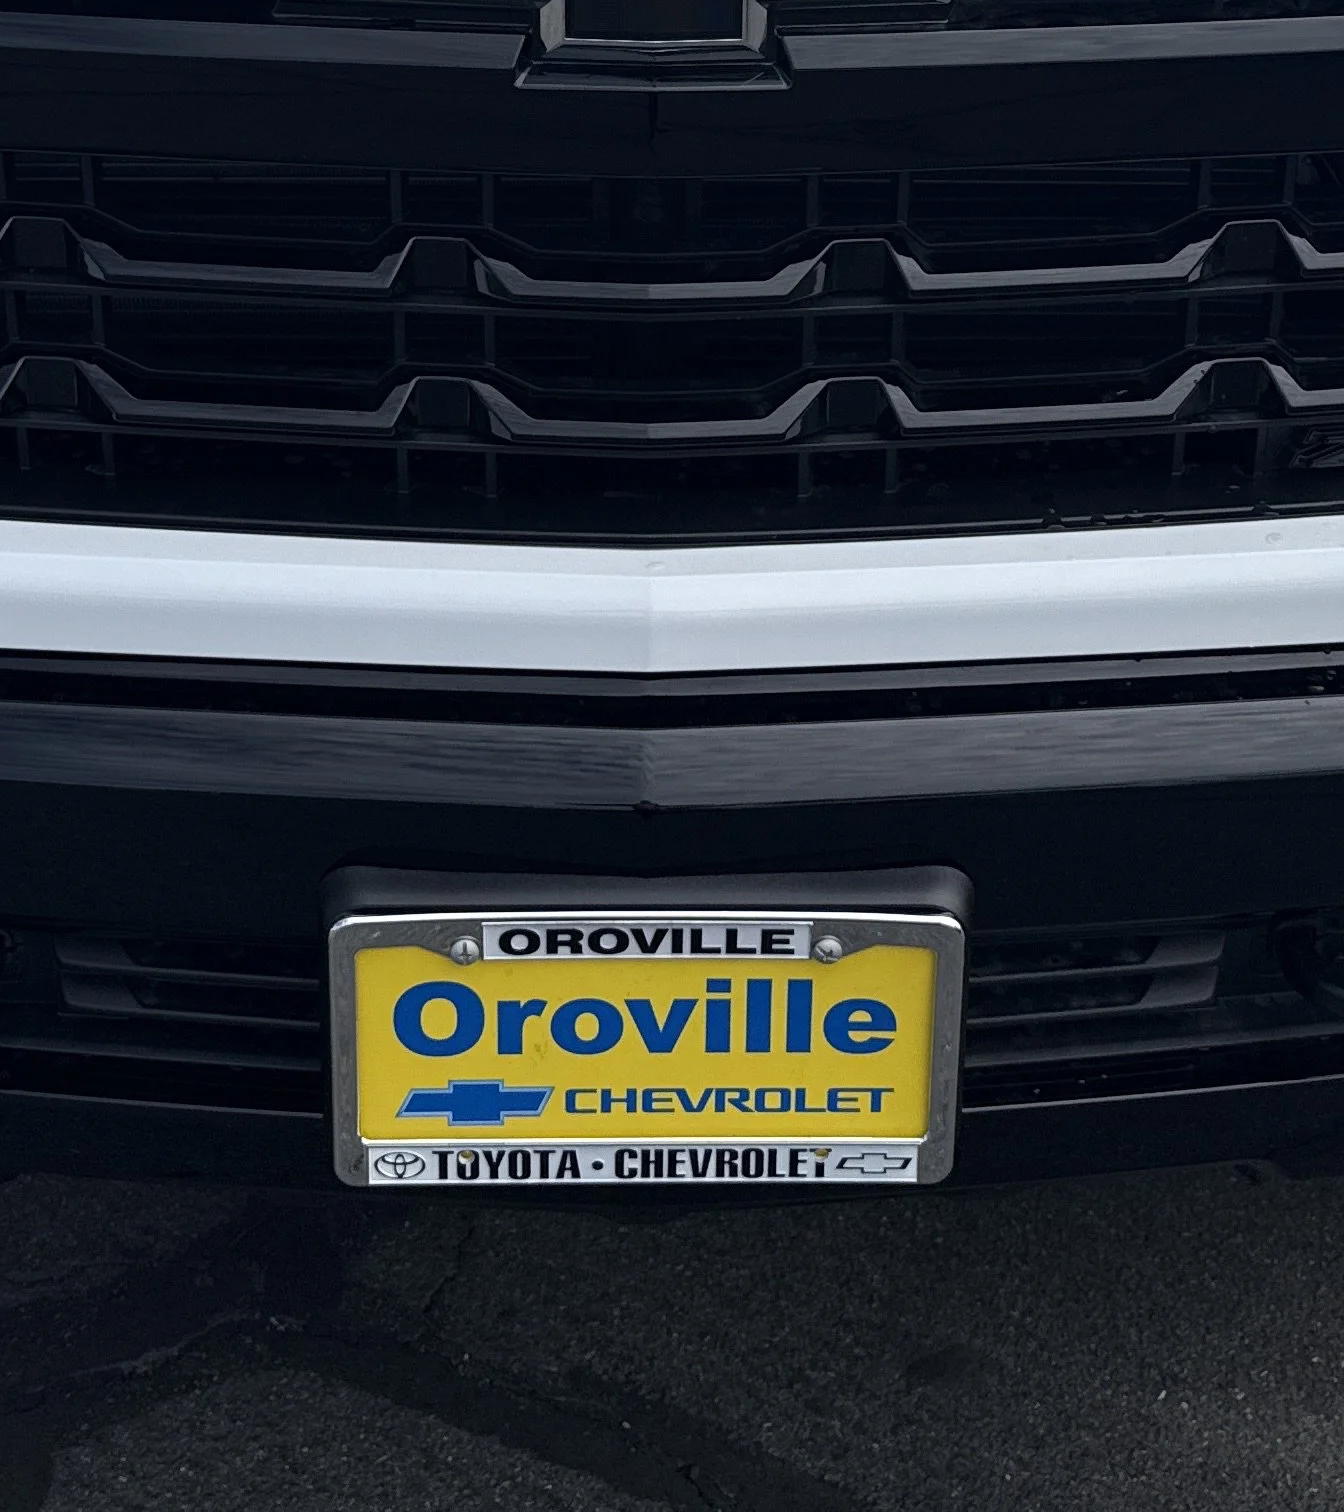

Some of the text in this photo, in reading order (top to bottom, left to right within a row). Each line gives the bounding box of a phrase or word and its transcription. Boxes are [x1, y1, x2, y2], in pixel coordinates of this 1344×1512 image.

[498, 927, 796, 955] OROVILLE
[392, 978, 897, 1057] Oroville
[564, 1087, 894, 1114] CHEVROLET
[432, 1147, 832, 1180] TOYOTA CHEVROLET
